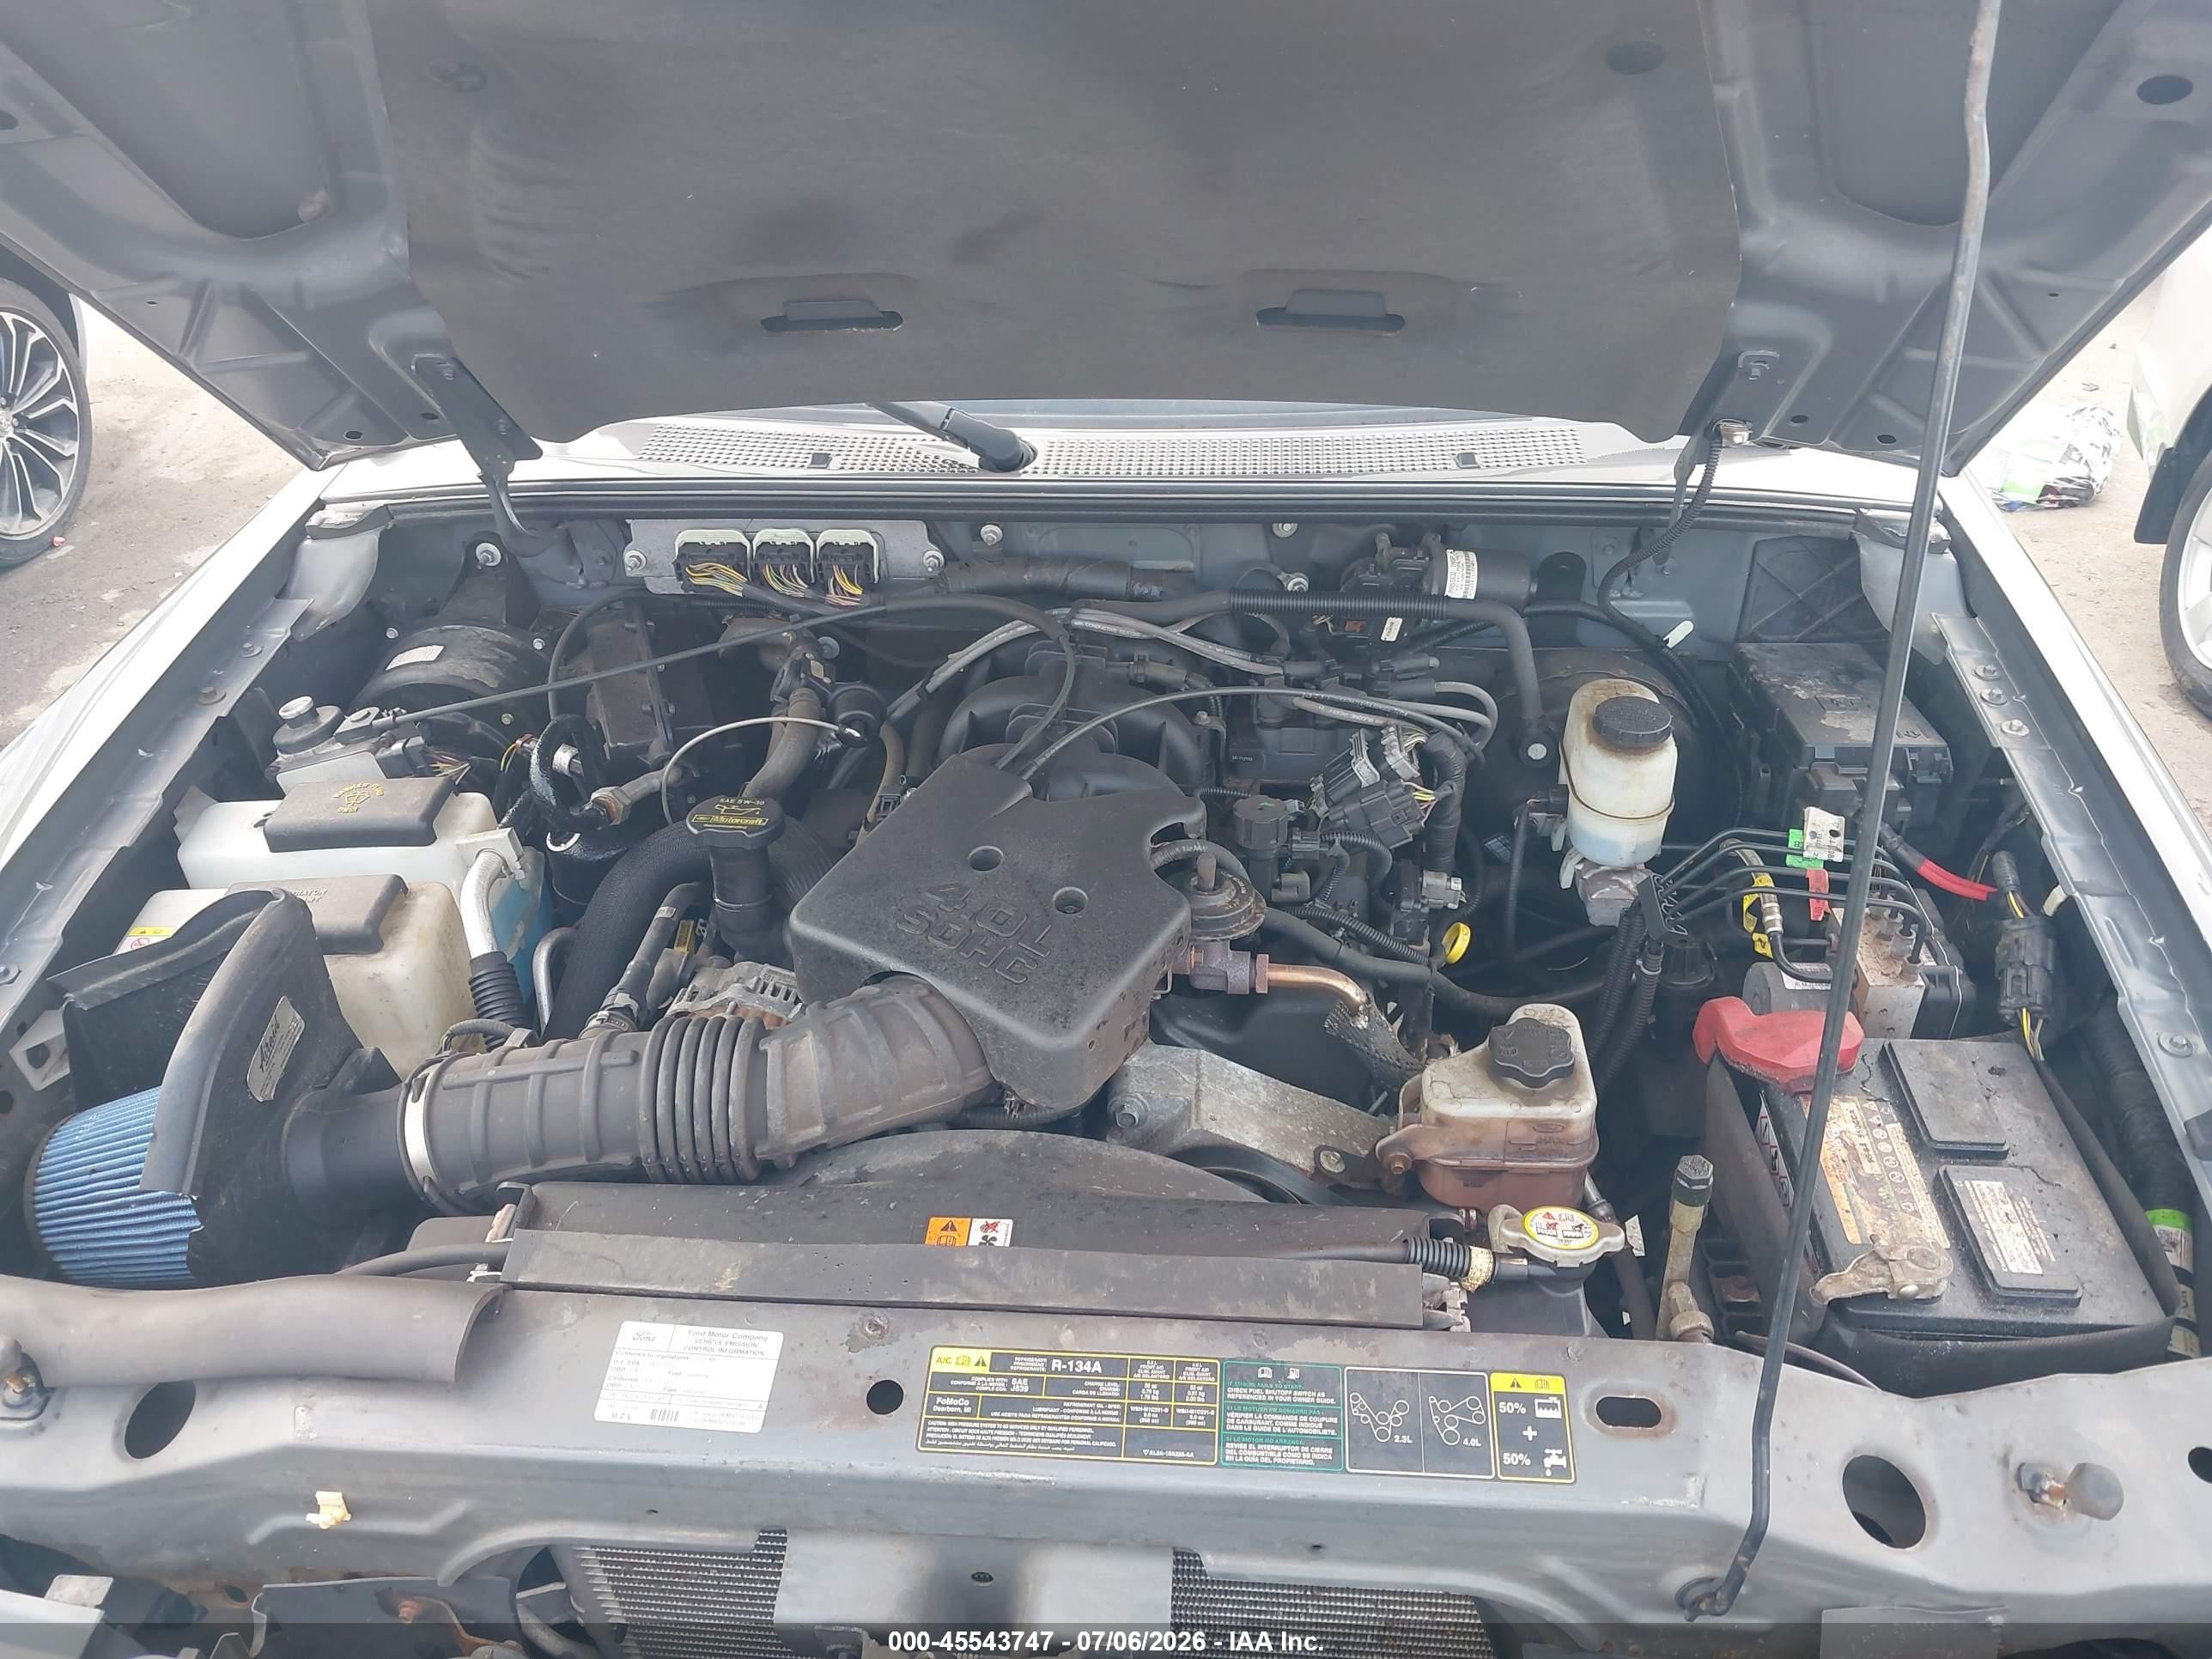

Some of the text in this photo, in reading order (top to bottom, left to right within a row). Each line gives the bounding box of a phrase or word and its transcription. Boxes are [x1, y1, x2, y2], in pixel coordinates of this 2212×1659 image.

[713, 815, 763, 824] Motorcraft
[896, 904, 1039, 984] SOHC
[708, 1330, 730, 1339] Motor
[732, 1332, 769, 1342] Company
[718, 1347, 765, 1356] INFORMATION
[936, 1357, 952, 1365] A/C
[1051, 1358, 1103, 1374] R-134A
[1012, 1377, 1029, 1386] SAE
[936, 1397, 969, 1406] FoMoCo
[933, 1405, 963, 1413] Dearborn,
[1498, 1401, 1527, 1414] 50%
[1394, 1435, 1413, 1443] 2.3L
[1462, 1437, 1482, 1447] 4.0L
[1238, 1449, 1281, 1458] COMBUSTIBLE
[1503, 1453, 1531, 1466] 50%
